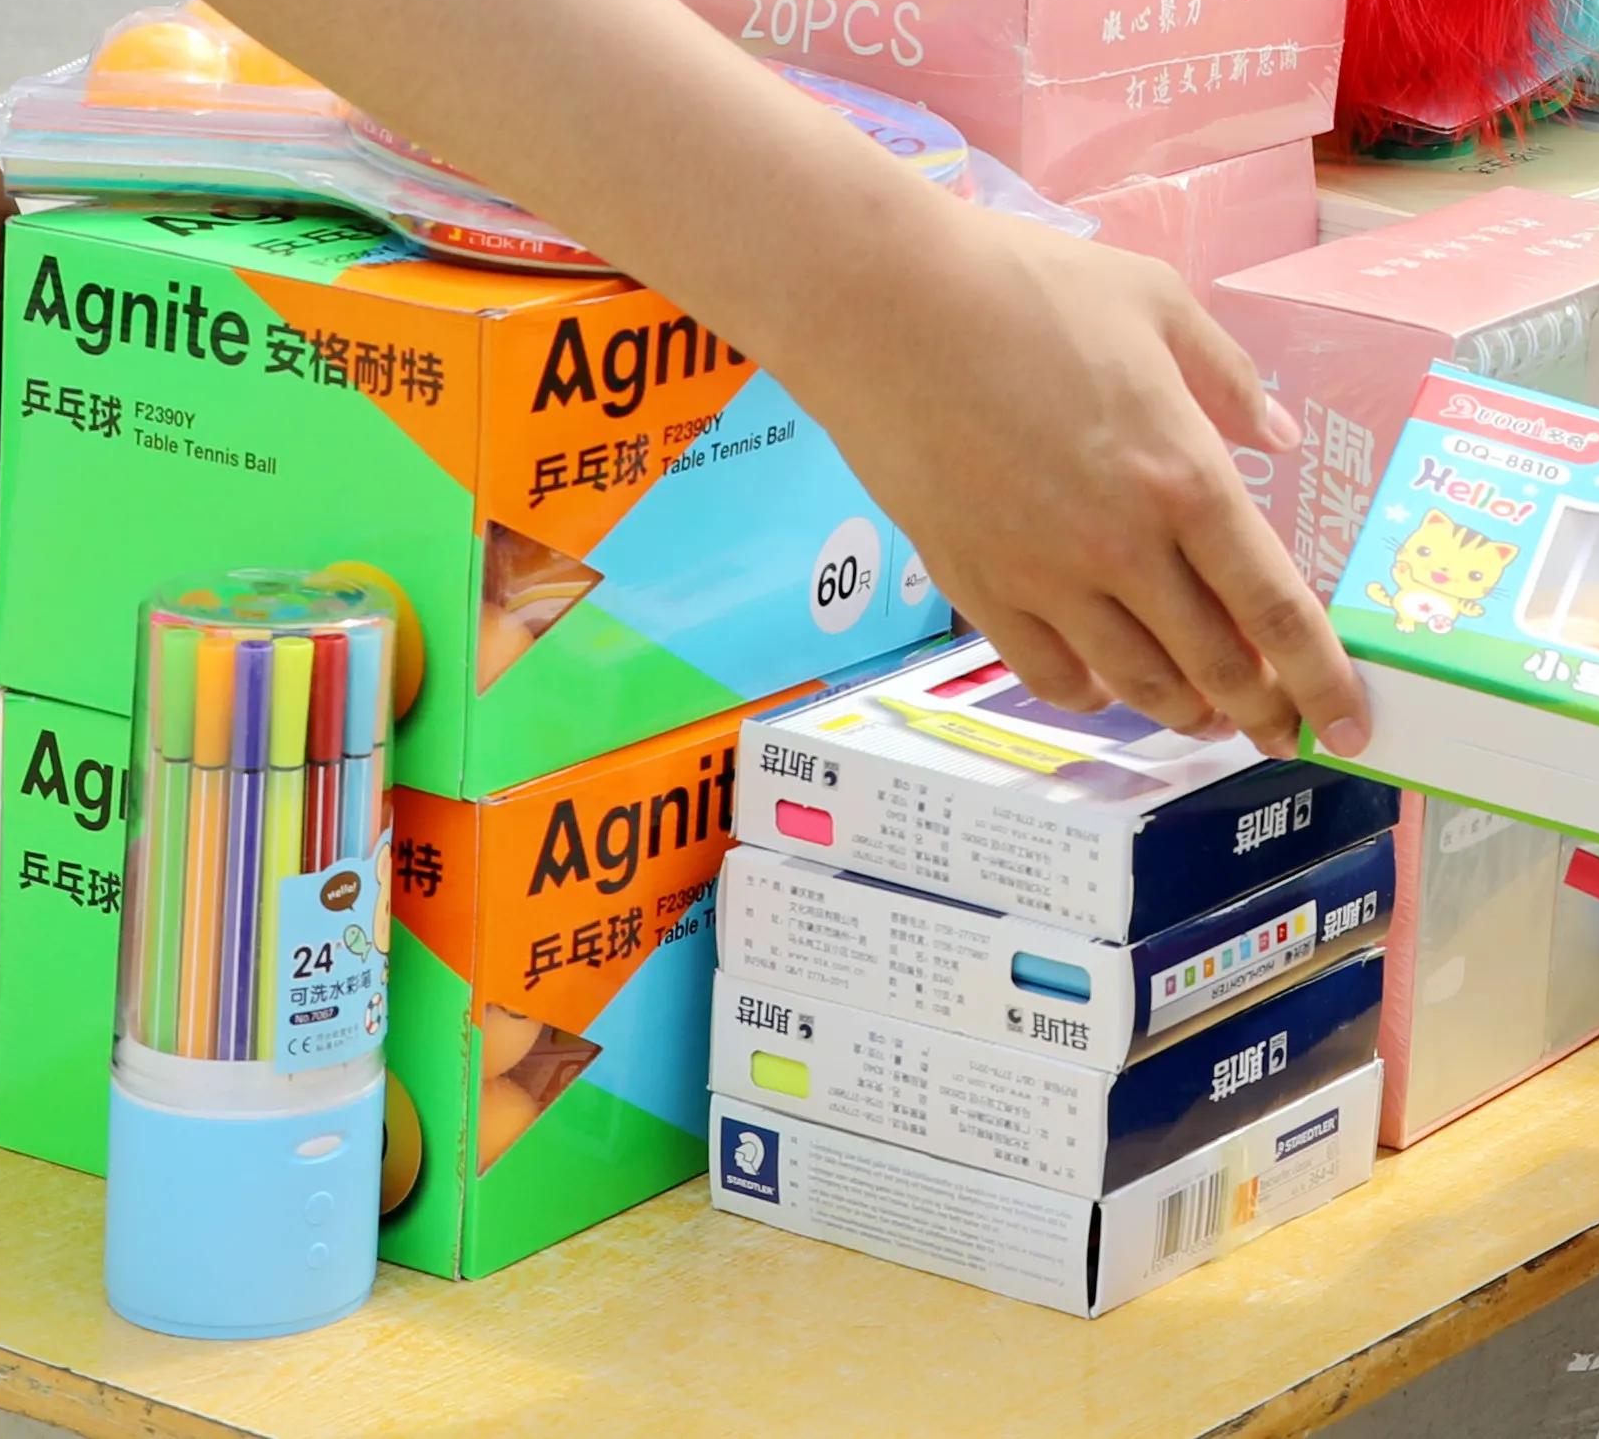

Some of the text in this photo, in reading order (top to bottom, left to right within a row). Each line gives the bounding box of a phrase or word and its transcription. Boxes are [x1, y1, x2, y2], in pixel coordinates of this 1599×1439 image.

[23, 254, 445, 407] Agnite 安格耐特
[21, 378, 122, 439] 乒乓球
[134, 401, 196, 431] F2390Y
[661, 420, 795, 477] Table Tennis Ball
[662, 412, 724, 447] F2390Y
[134, 429, 277, 476] Table Tennis Ball
[528, 433, 650, 510] 乒乓球
[1453, 439, 1561, 480] DQ-8810
[1410, 458, 1536, 522] Hello!
[760, 743, 818, 782] 斯塔
[1233, 797, 1291, 855] 斯塔
[17, 850, 122, 916] 乒乓球
[653, 919, 699, 949] Table
[1322, 898, 1361, 942] 斯塔
[292, 942, 333, 979] 24
[523, 905, 643, 992] 乒乓球
[290, 969, 372, 1006] 可洗水彩笔
[1211, 962, 1275, 999] HIGHLIGHTER
[735, 995, 792, 1036] 斯塔
[1031, 1012, 1091, 1050] 斯塔
[1210, 1040, 1266, 1102] 斯塔
[1284, 1118, 1335, 1152] STAEDTLER
[726, 1175, 777, 1197] STAEDTLER
